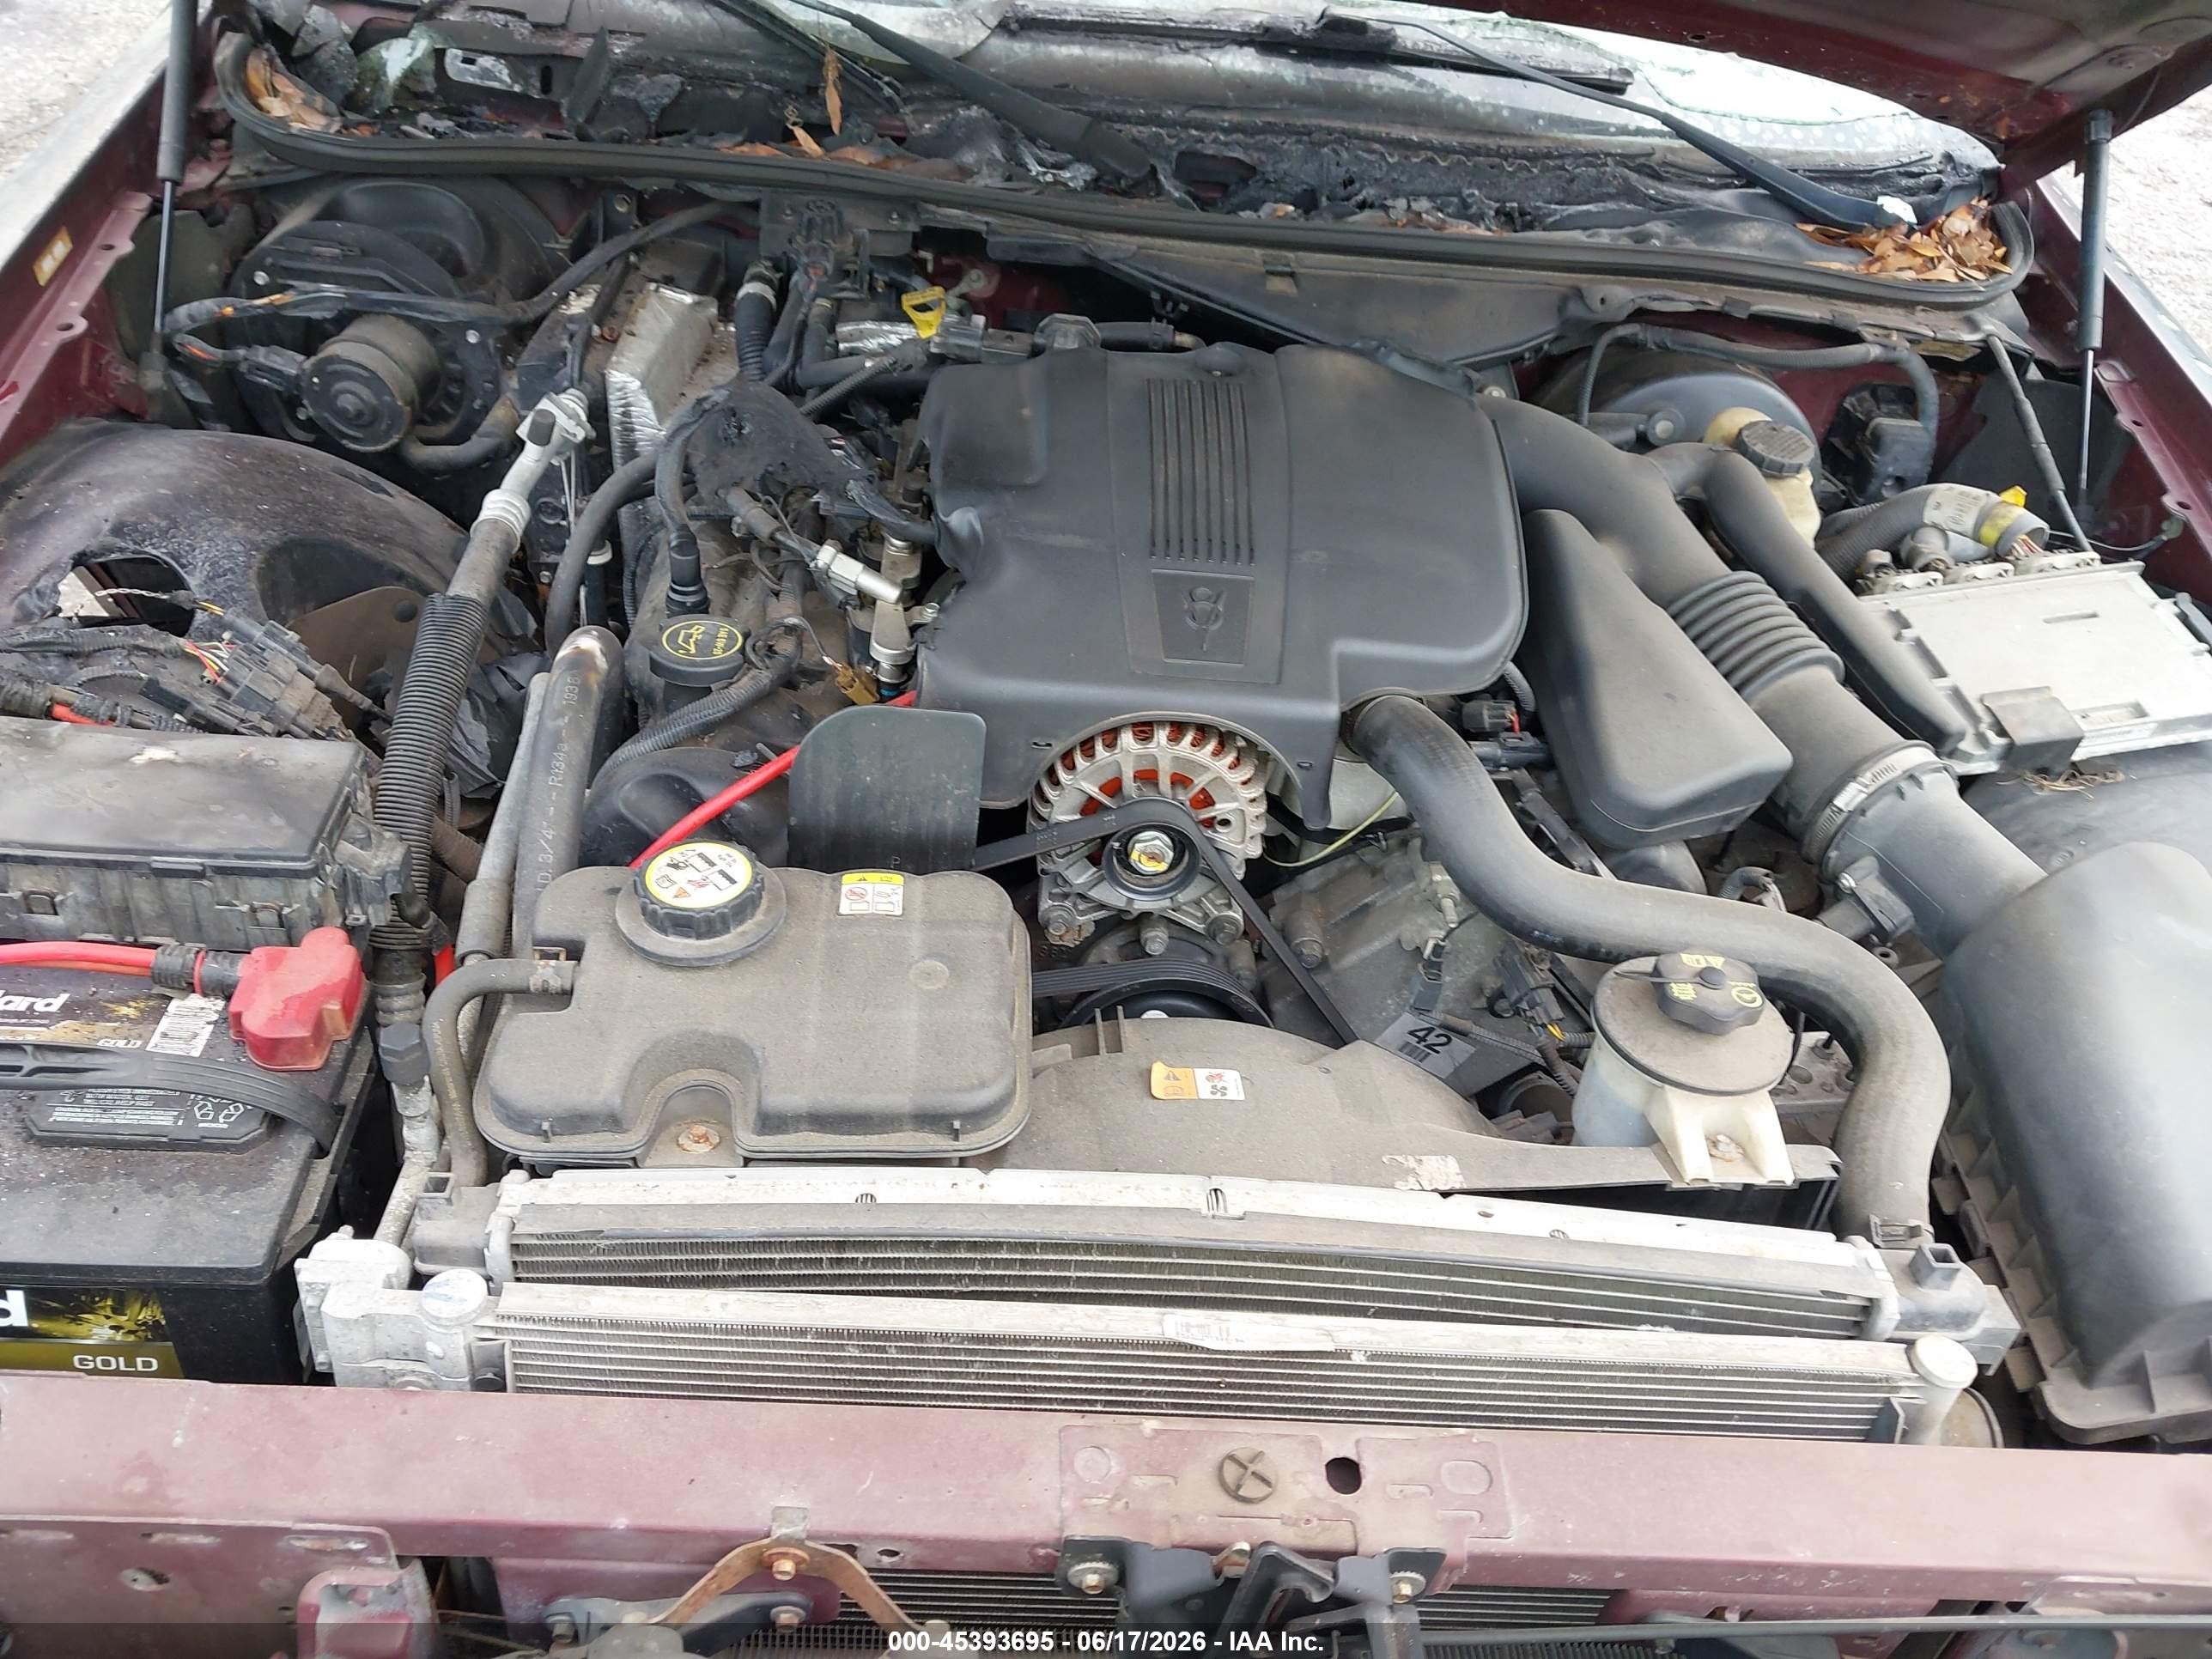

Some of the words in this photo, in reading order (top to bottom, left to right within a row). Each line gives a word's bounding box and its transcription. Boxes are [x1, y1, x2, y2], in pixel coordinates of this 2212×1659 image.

[548, 742, 568, 788] R134a
[0, 990, 70, 1012] ard
[96, 1037, 143, 1049] GOLD
[1407, 1026, 1452, 1054] 42
[73, 1354, 159, 1372] GOLD
